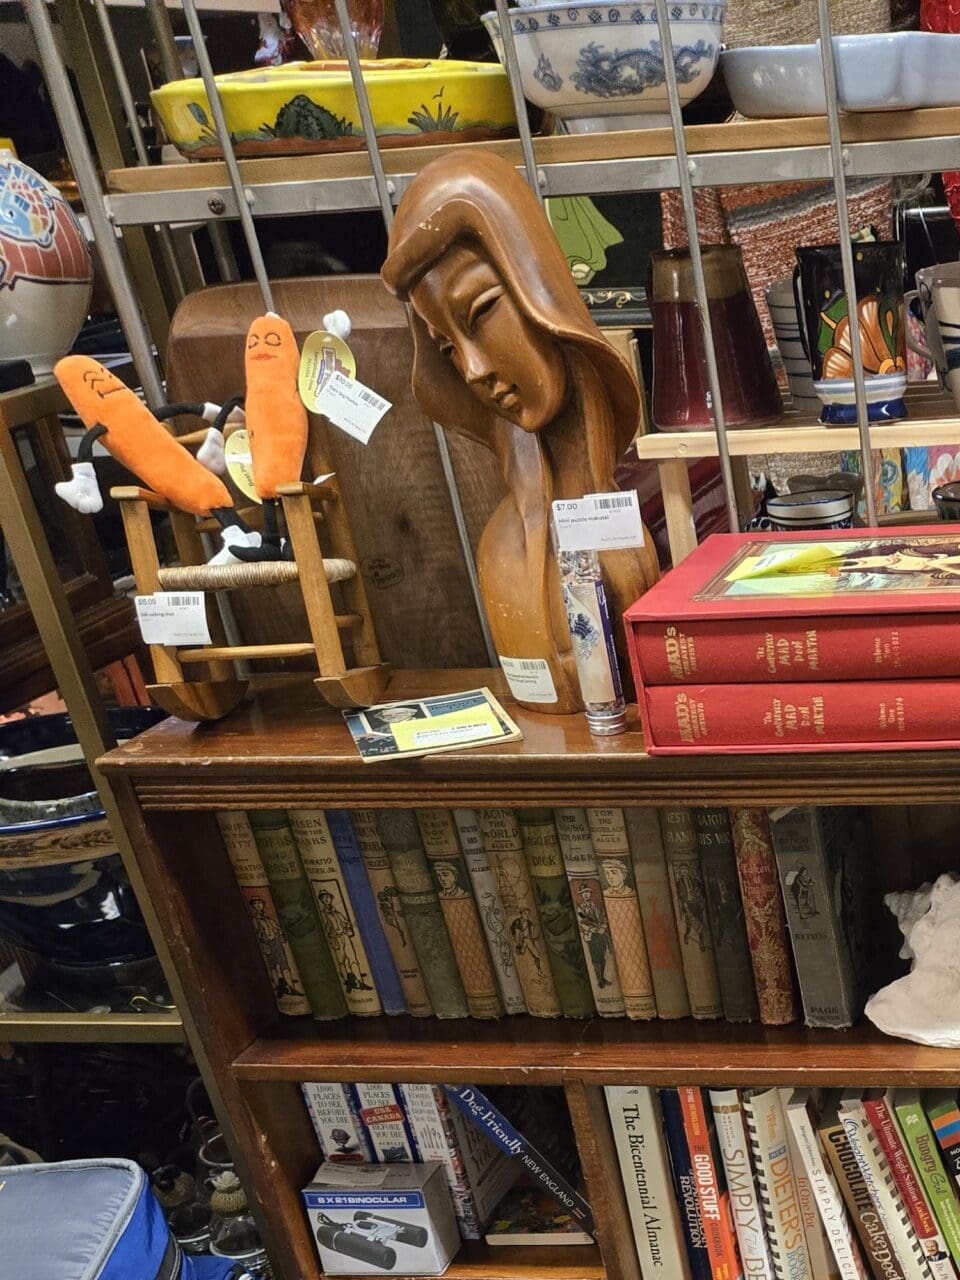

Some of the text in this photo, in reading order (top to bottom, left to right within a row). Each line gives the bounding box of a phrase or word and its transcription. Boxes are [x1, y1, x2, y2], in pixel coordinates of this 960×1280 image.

[556, 503, 578, 511] $7.00
[778, 638, 792, 666] MAD
[806, 630, 820, 671] MARTIN
[812, 696, 826, 734] MARTIN
[532, 856, 556, 866] DICK
[312, 1092, 342, 1100] PLACES
[328, 1100, 342, 1108] SEE
[362, 1092, 390, 1100] PLACES
[373, 1106, 390, 1116] USA
[318, 1108, 346, 1116] BEFORE
[336, 1116, 350, 1124] DIE
[366, 1112, 402, 1123] CANADA
[374, 1130, 403, 1139] YOU DIE
[459, 1087, 575, 1208] Dog-Friendly NEW ENGLAND
[693, 1154, 710, 1184] GOOD
[875, 1104, 885, 1118] The
[880, 1116, 897, 1149] Ultimate
[894, 1146, 906, 1174] Weight
[914, 1202, 934, 1234] Cookbook
[622, 1104, 663, 1268] The Bicentennial Almanac
[722, 1149, 758, 1236] SIMPLY
[812, 1169, 835, 1223] SIMPLY
[680, 1176, 702, 1248] REVOLUTION
[700, 1184, 721, 1221] STUFF
[770, 1157, 804, 1250] DIETER'S
[795, 1245, 809, 1279] COOK
